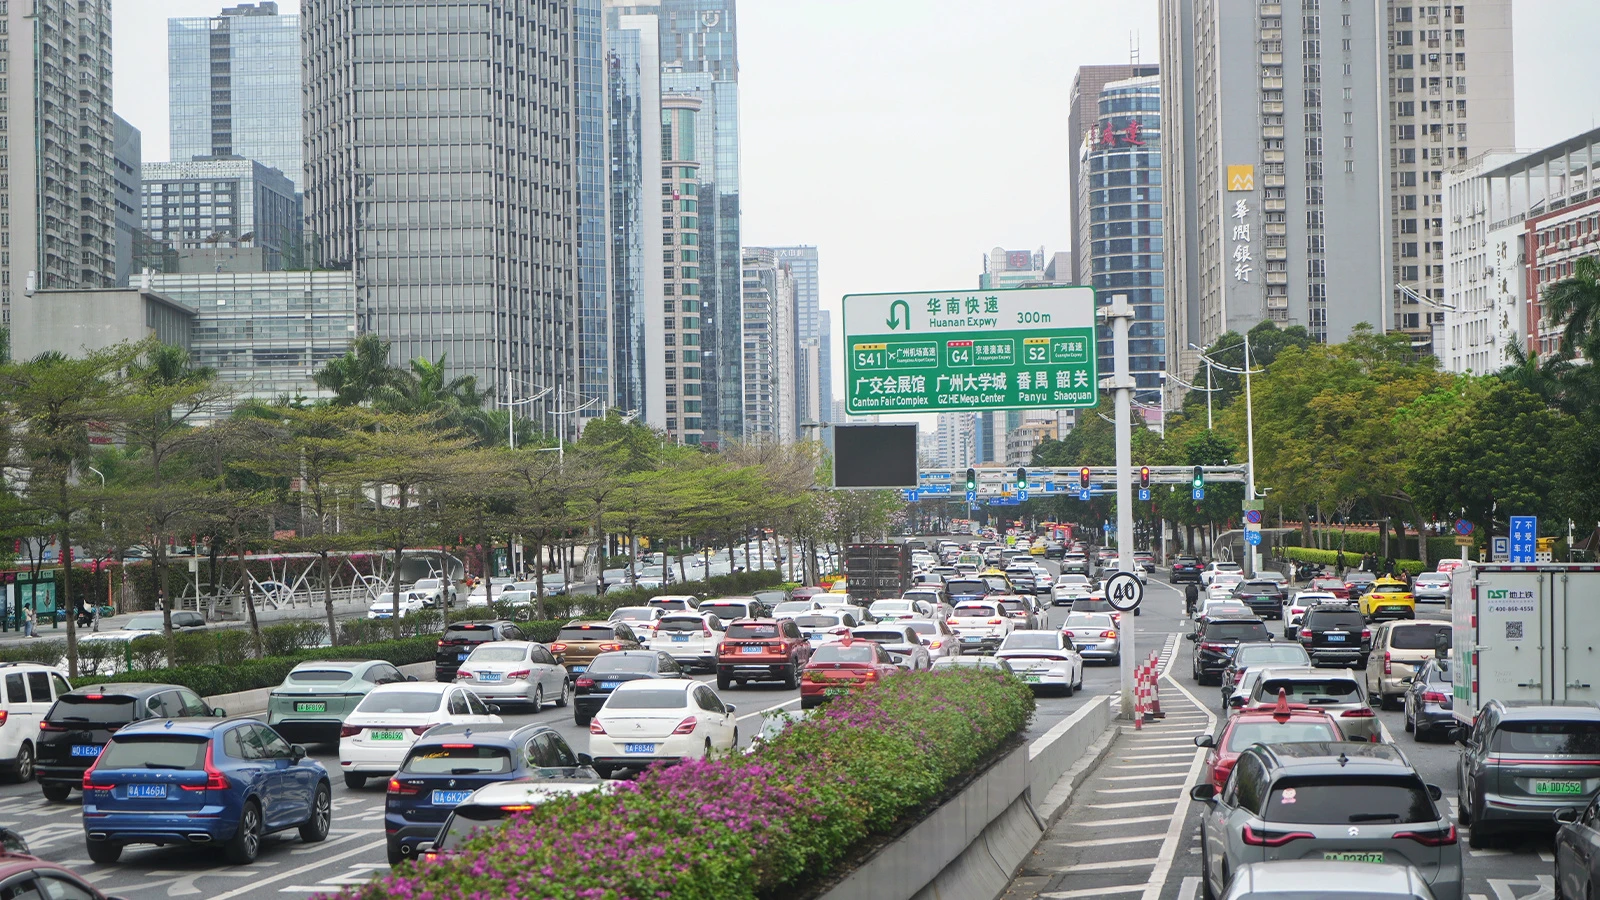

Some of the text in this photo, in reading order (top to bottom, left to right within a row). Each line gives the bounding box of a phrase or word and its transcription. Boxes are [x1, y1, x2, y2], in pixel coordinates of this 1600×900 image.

[927, 296, 999, 315] 华南快速
[930, 317, 997, 328] Huanan Expwy
[1017, 312, 1051, 324] 300m
[896, 347, 936, 357] 广州机场高速
[1029, 347, 1045, 360] S2
[1054, 342, 1083, 352] 广河高速
[858, 353, 880, 366] S41
[952, 350, 968, 362] G4
[855, 375, 925, 394] 广交会展馆
[936, 372, 1007, 392] 广州大学城
[1016, 371, 1048, 390] 番禺
[1056, 370, 1088, 388] 韶关
[852, 395, 928, 407] Canton Fair Complex
[938, 393, 1005, 406] GZ HE Mega Center
[1019, 392, 1047, 403] Panyu
[1054, 390, 1092, 403] Shaoguan
[1114, 582, 1135, 600] 40
[1488, 590, 1508, 598] DST
